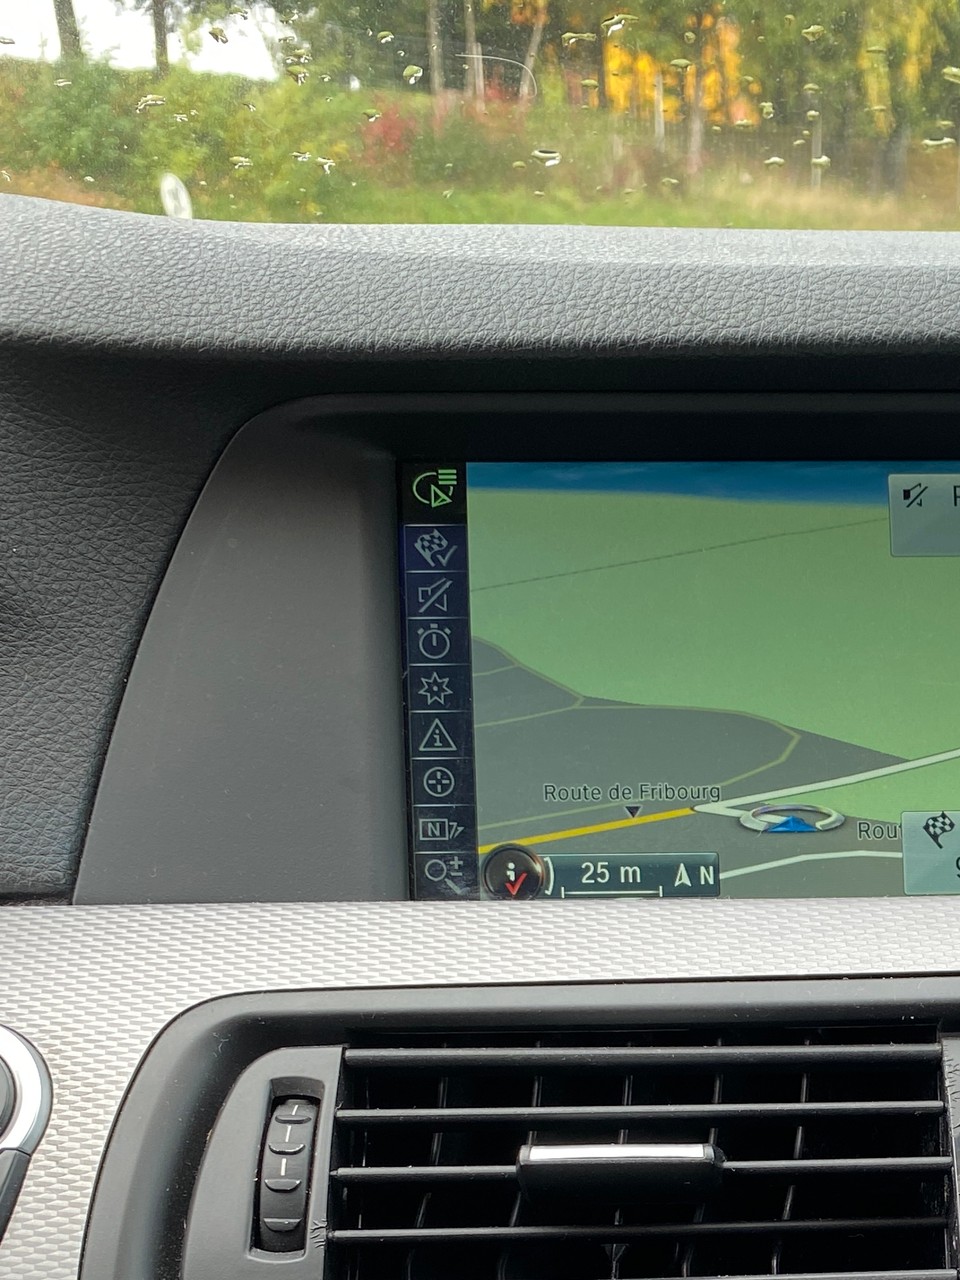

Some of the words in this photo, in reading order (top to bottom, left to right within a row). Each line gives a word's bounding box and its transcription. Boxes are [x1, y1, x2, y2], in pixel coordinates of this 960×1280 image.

[543, 784, 602, 801] Route
[608, 783, 633, 800] de
[639, 782, 721, 804] Fribourg
[581, 862, 610, 884] 25
[620, 866, 641, 883] m
[700, 866, 714, 885] N
